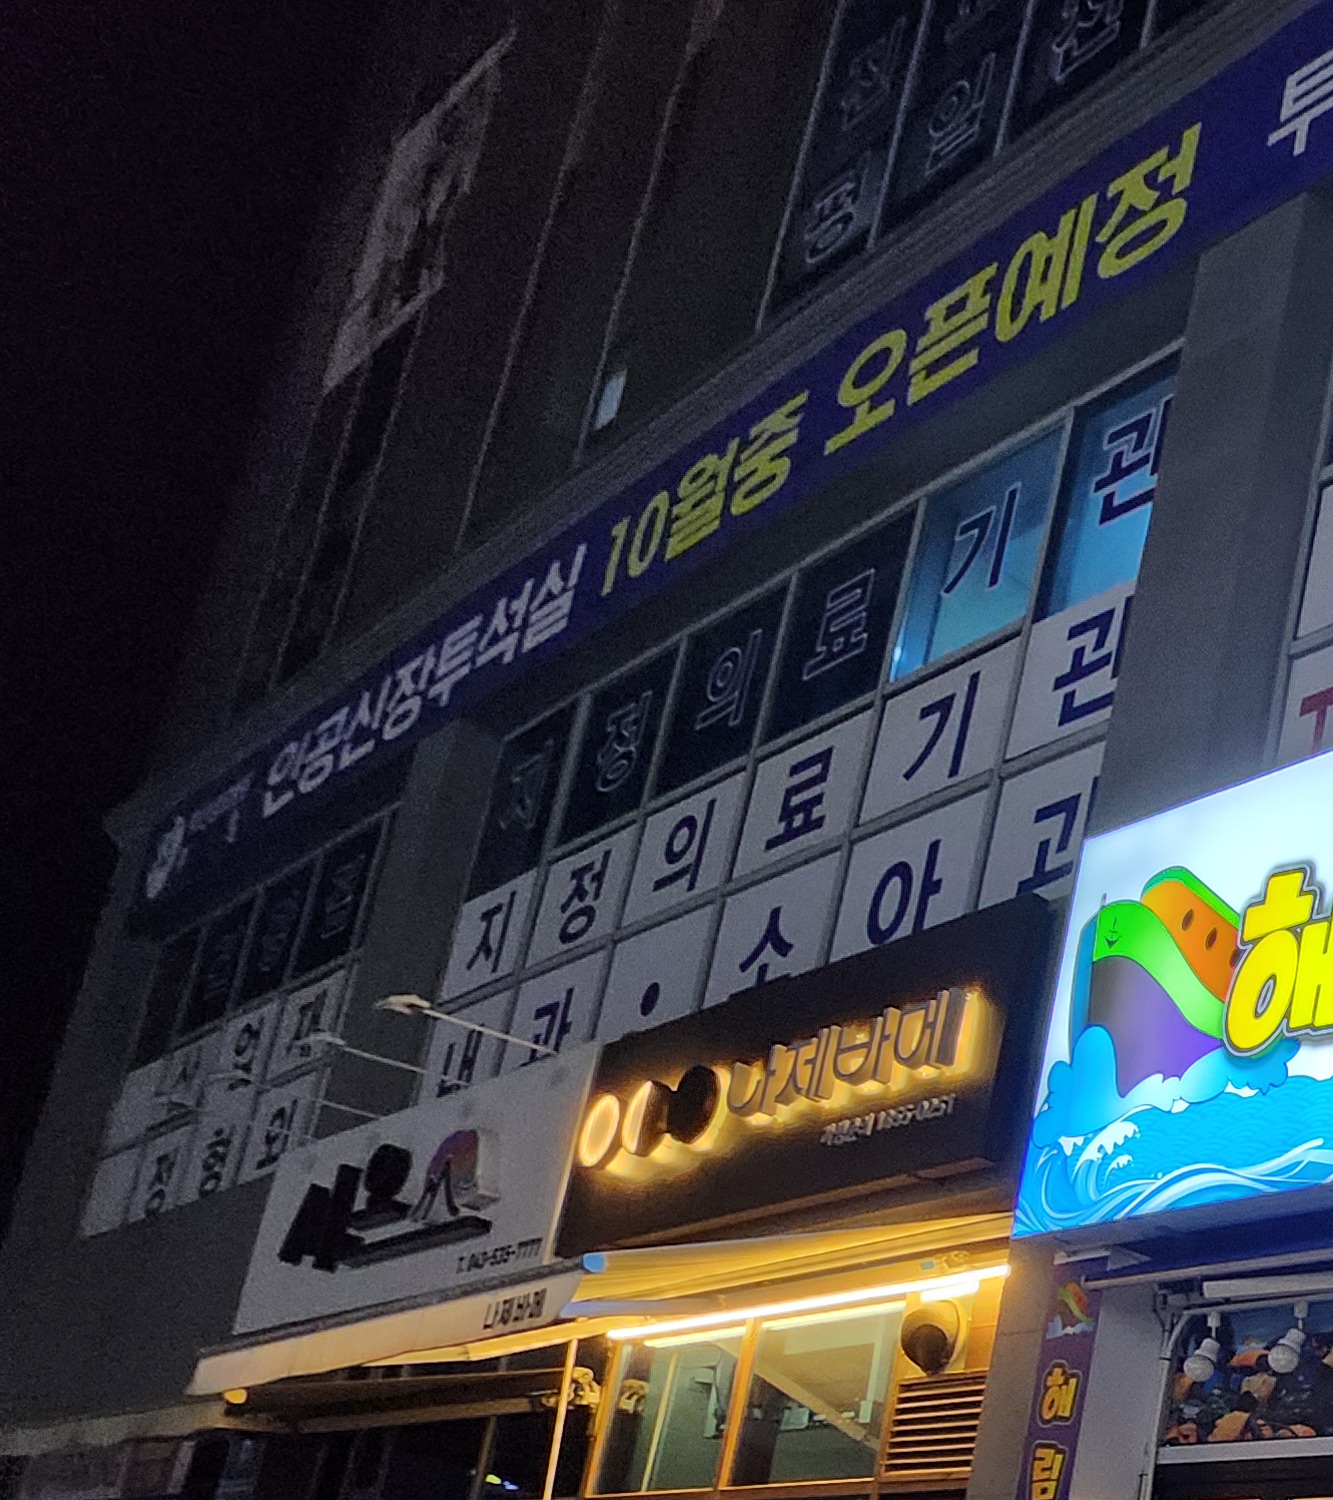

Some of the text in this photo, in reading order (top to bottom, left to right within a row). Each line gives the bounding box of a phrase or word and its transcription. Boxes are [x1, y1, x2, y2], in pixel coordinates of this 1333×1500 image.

[262, 545, 586, 820] 인공신장투석실
[600, 392, 808, 596] 10월중
[824, 122, 1202, 457] 오픈예정
